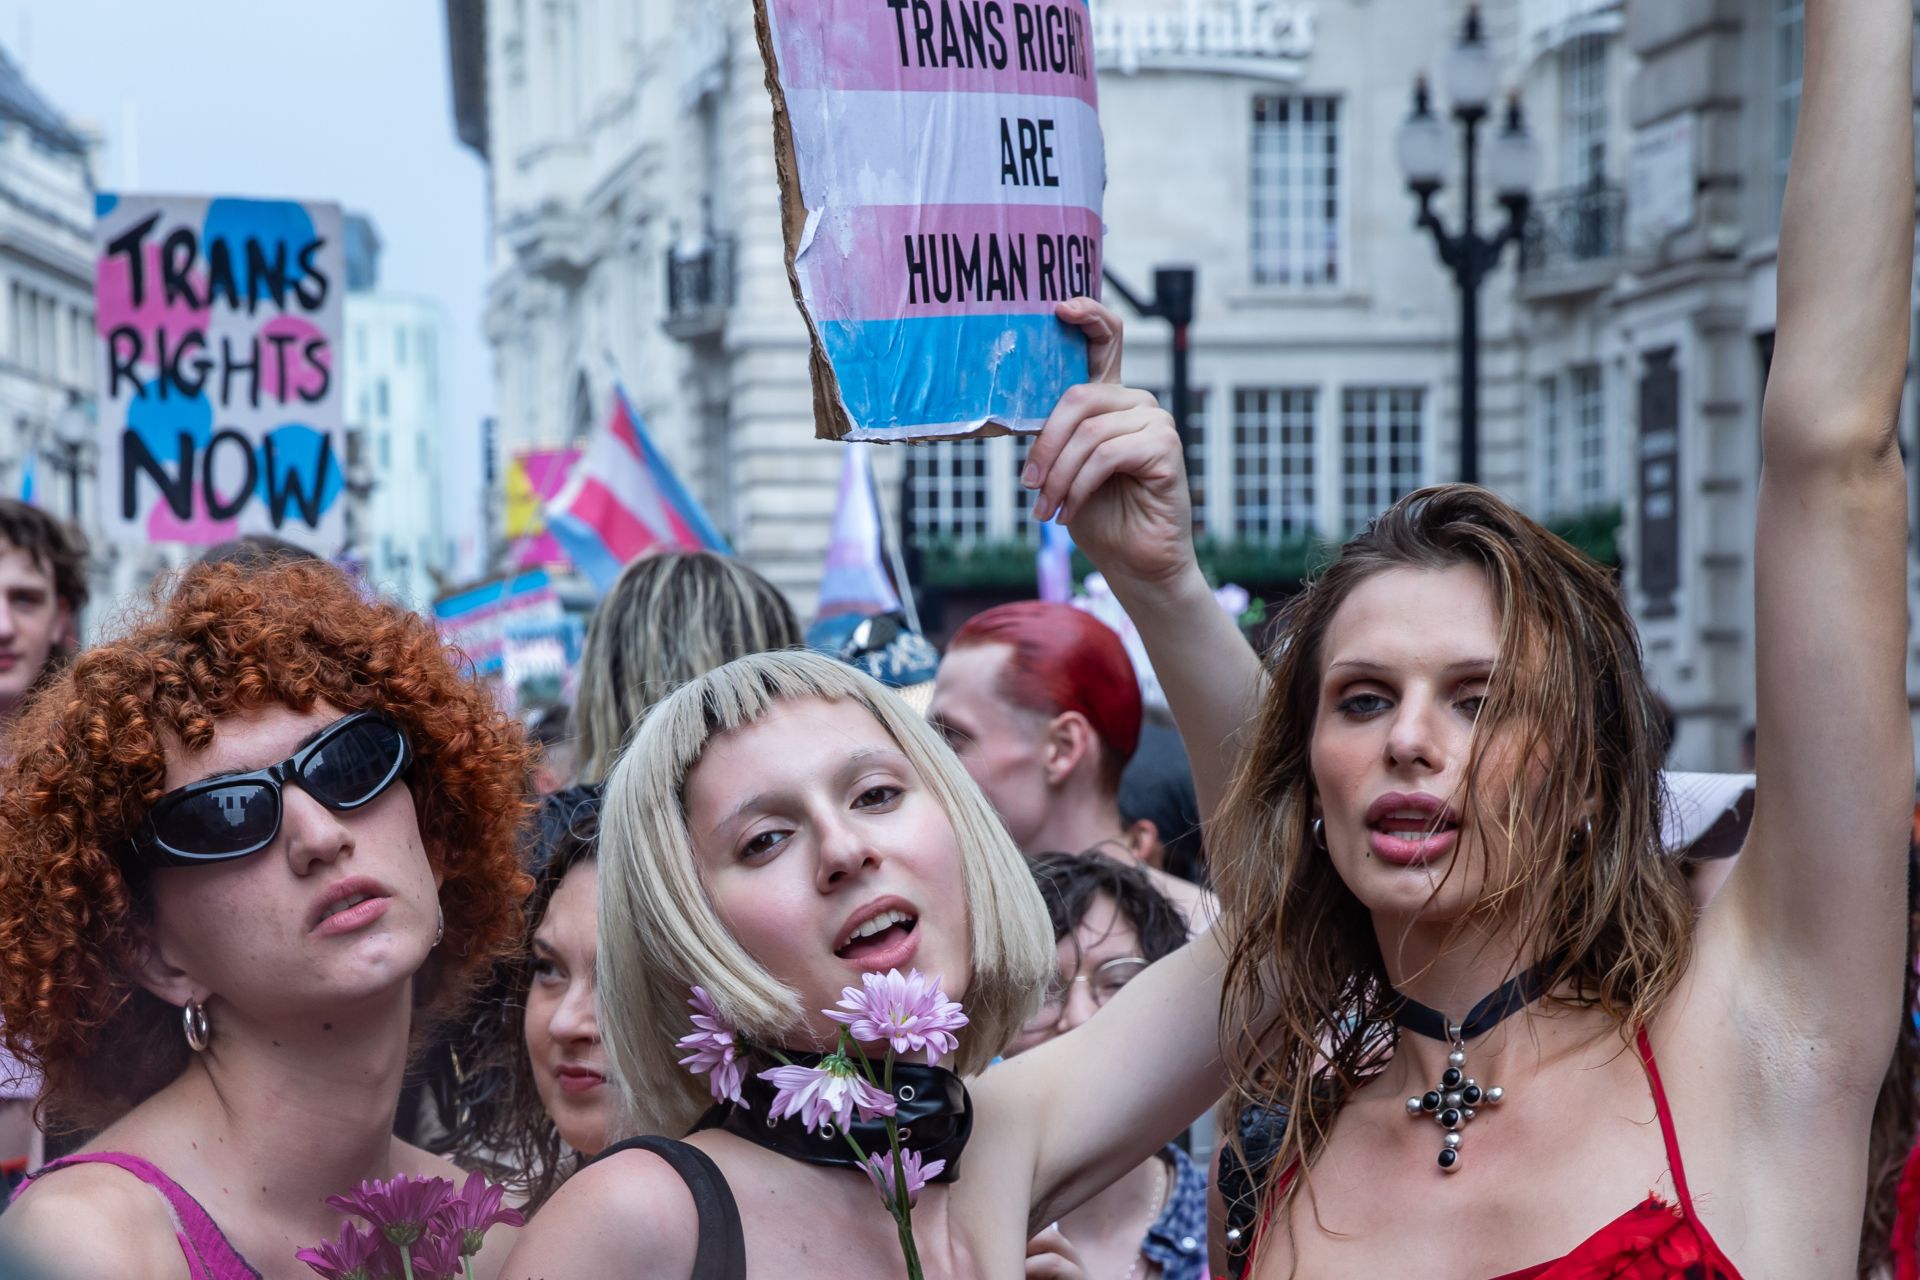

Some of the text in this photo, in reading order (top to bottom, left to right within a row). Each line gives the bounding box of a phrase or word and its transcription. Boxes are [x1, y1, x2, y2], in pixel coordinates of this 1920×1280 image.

[887, 0, 1008, 71] TRANS
[1000, 117, 1060, 187] ARE
[107, 210, 327, 316] TRANS
[904, 233, 1029, 304] HUMAN
[109, 324, 331, 408] RIGHTS
[122, 429, 331, 530] NOW
